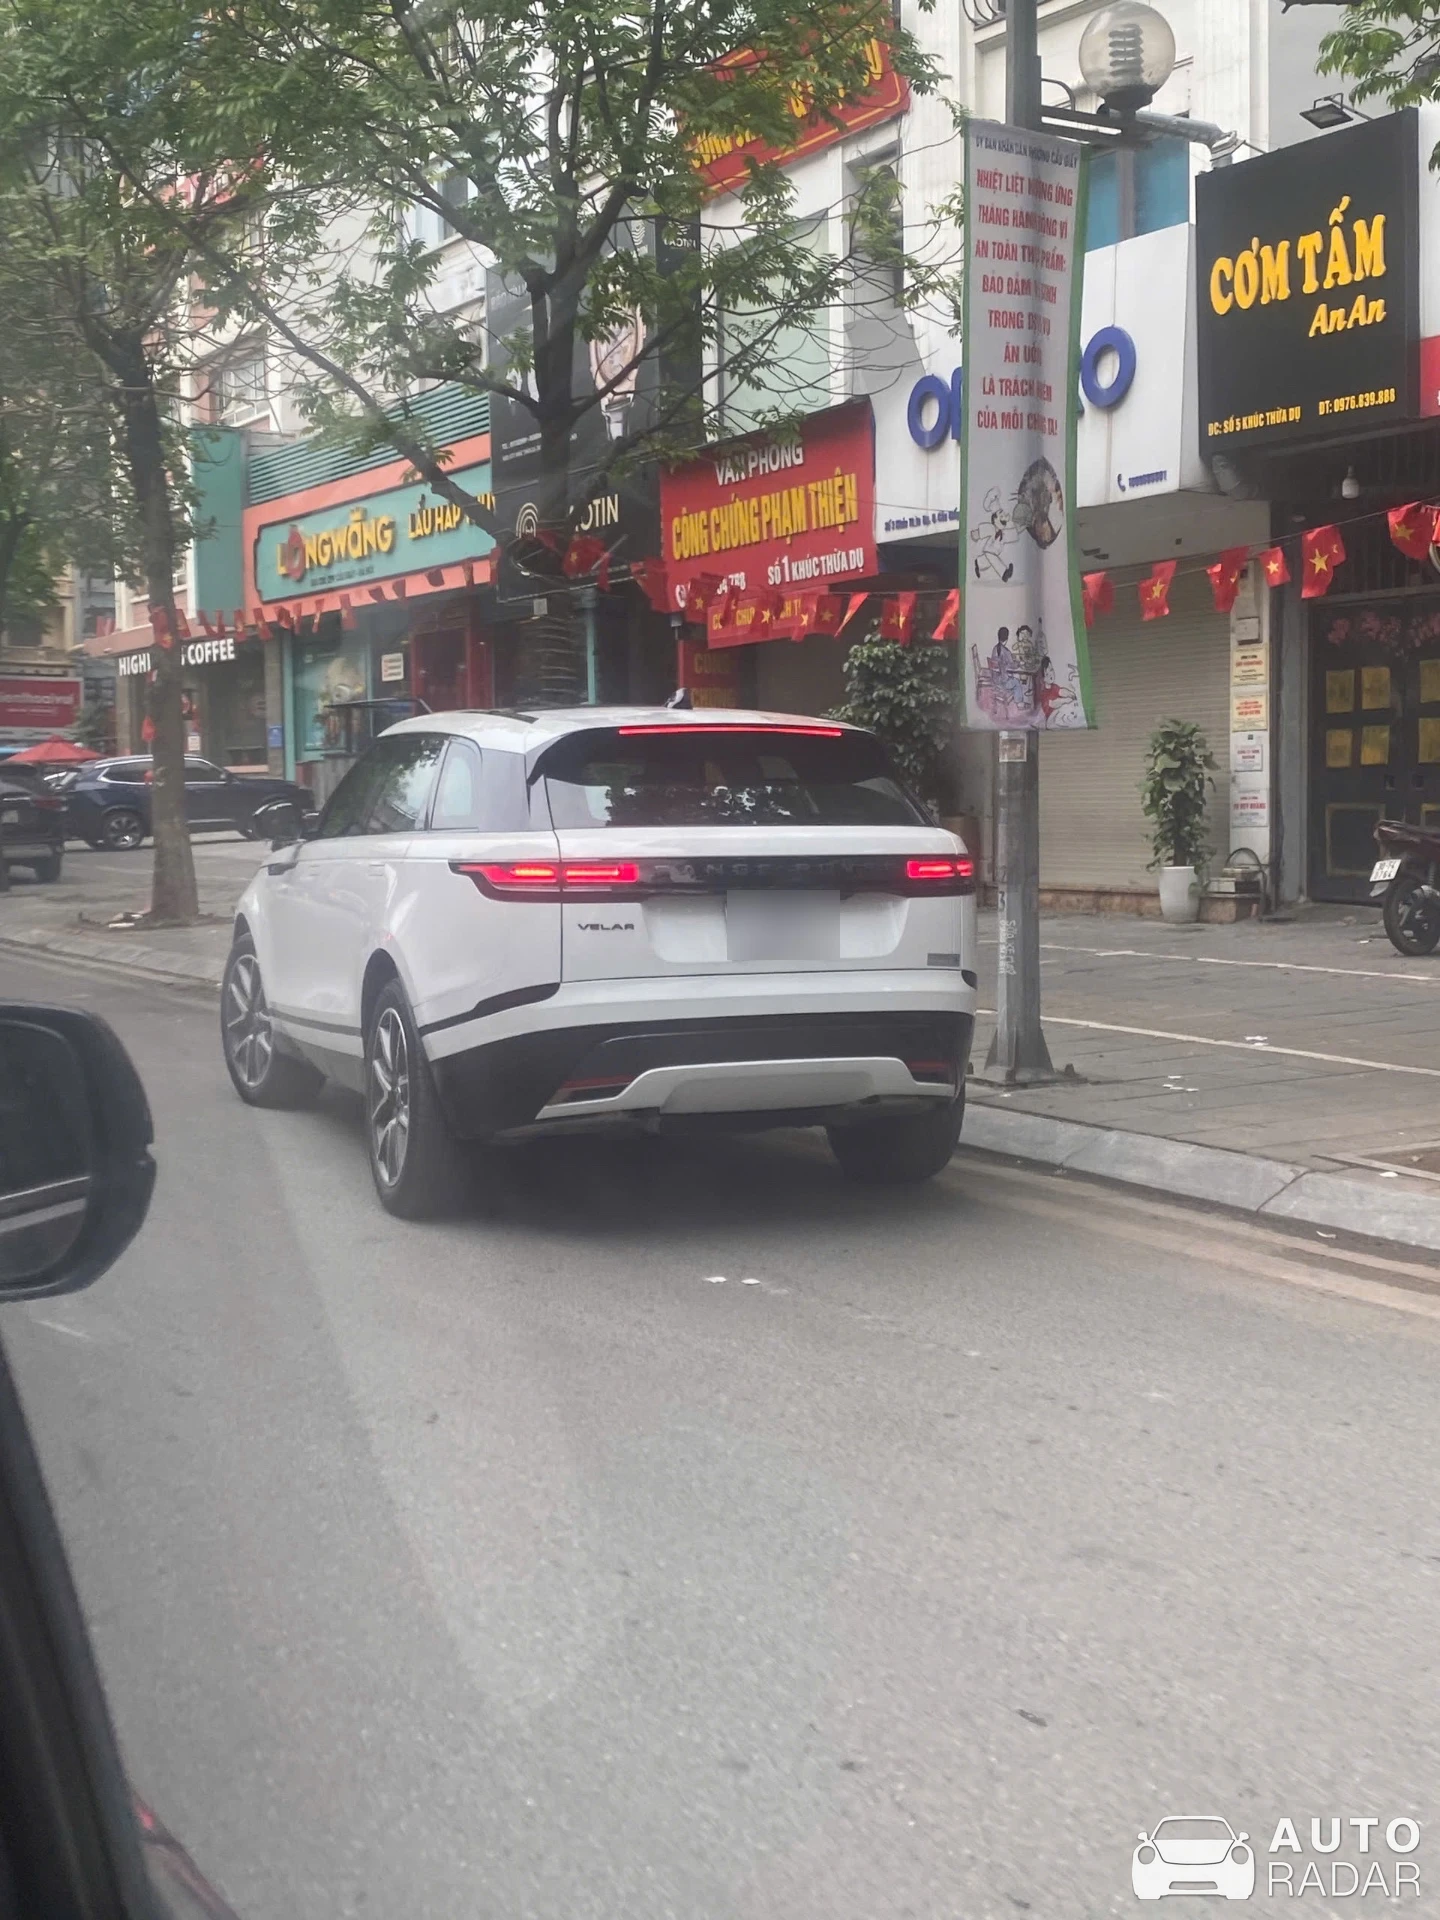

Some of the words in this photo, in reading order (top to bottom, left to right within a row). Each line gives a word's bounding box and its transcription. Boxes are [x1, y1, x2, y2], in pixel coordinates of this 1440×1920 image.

[975, 239, 989, 259] AN
[1210, 236, 1291, 315] CƠM
[1297, 195, 1387, 294] TẤM
[988, 309, 1025, 330] TRONG
[982, 373, 995, 396] LÀ
[977, 405, 998, 430] CỦA
[1223, 414, 1234, 434] SỐ
[1235, 420, 1241, 432] 5
[1242, 410, 1265, 431] KHÚC
[1265, 406, 1287, 426] THỪA
[672, 507, 709, 561] CÔNG
[709, 493, 760, 552] CHỨNG
[760, 486, 809, 546] PHẠM
[808, 466, 858, 534] THIỆN
[768, 556, 781, 586] SỐ
[781, 554, 790, 583] 1
[791, 553, 820, 580] KHÚC
[820, 547, 849, 574] THỪA
[850, 547, 865, 573] DỤ
[187, 638, 235, 665] COFFEE
[577, 923, 635, 931] VELAR
